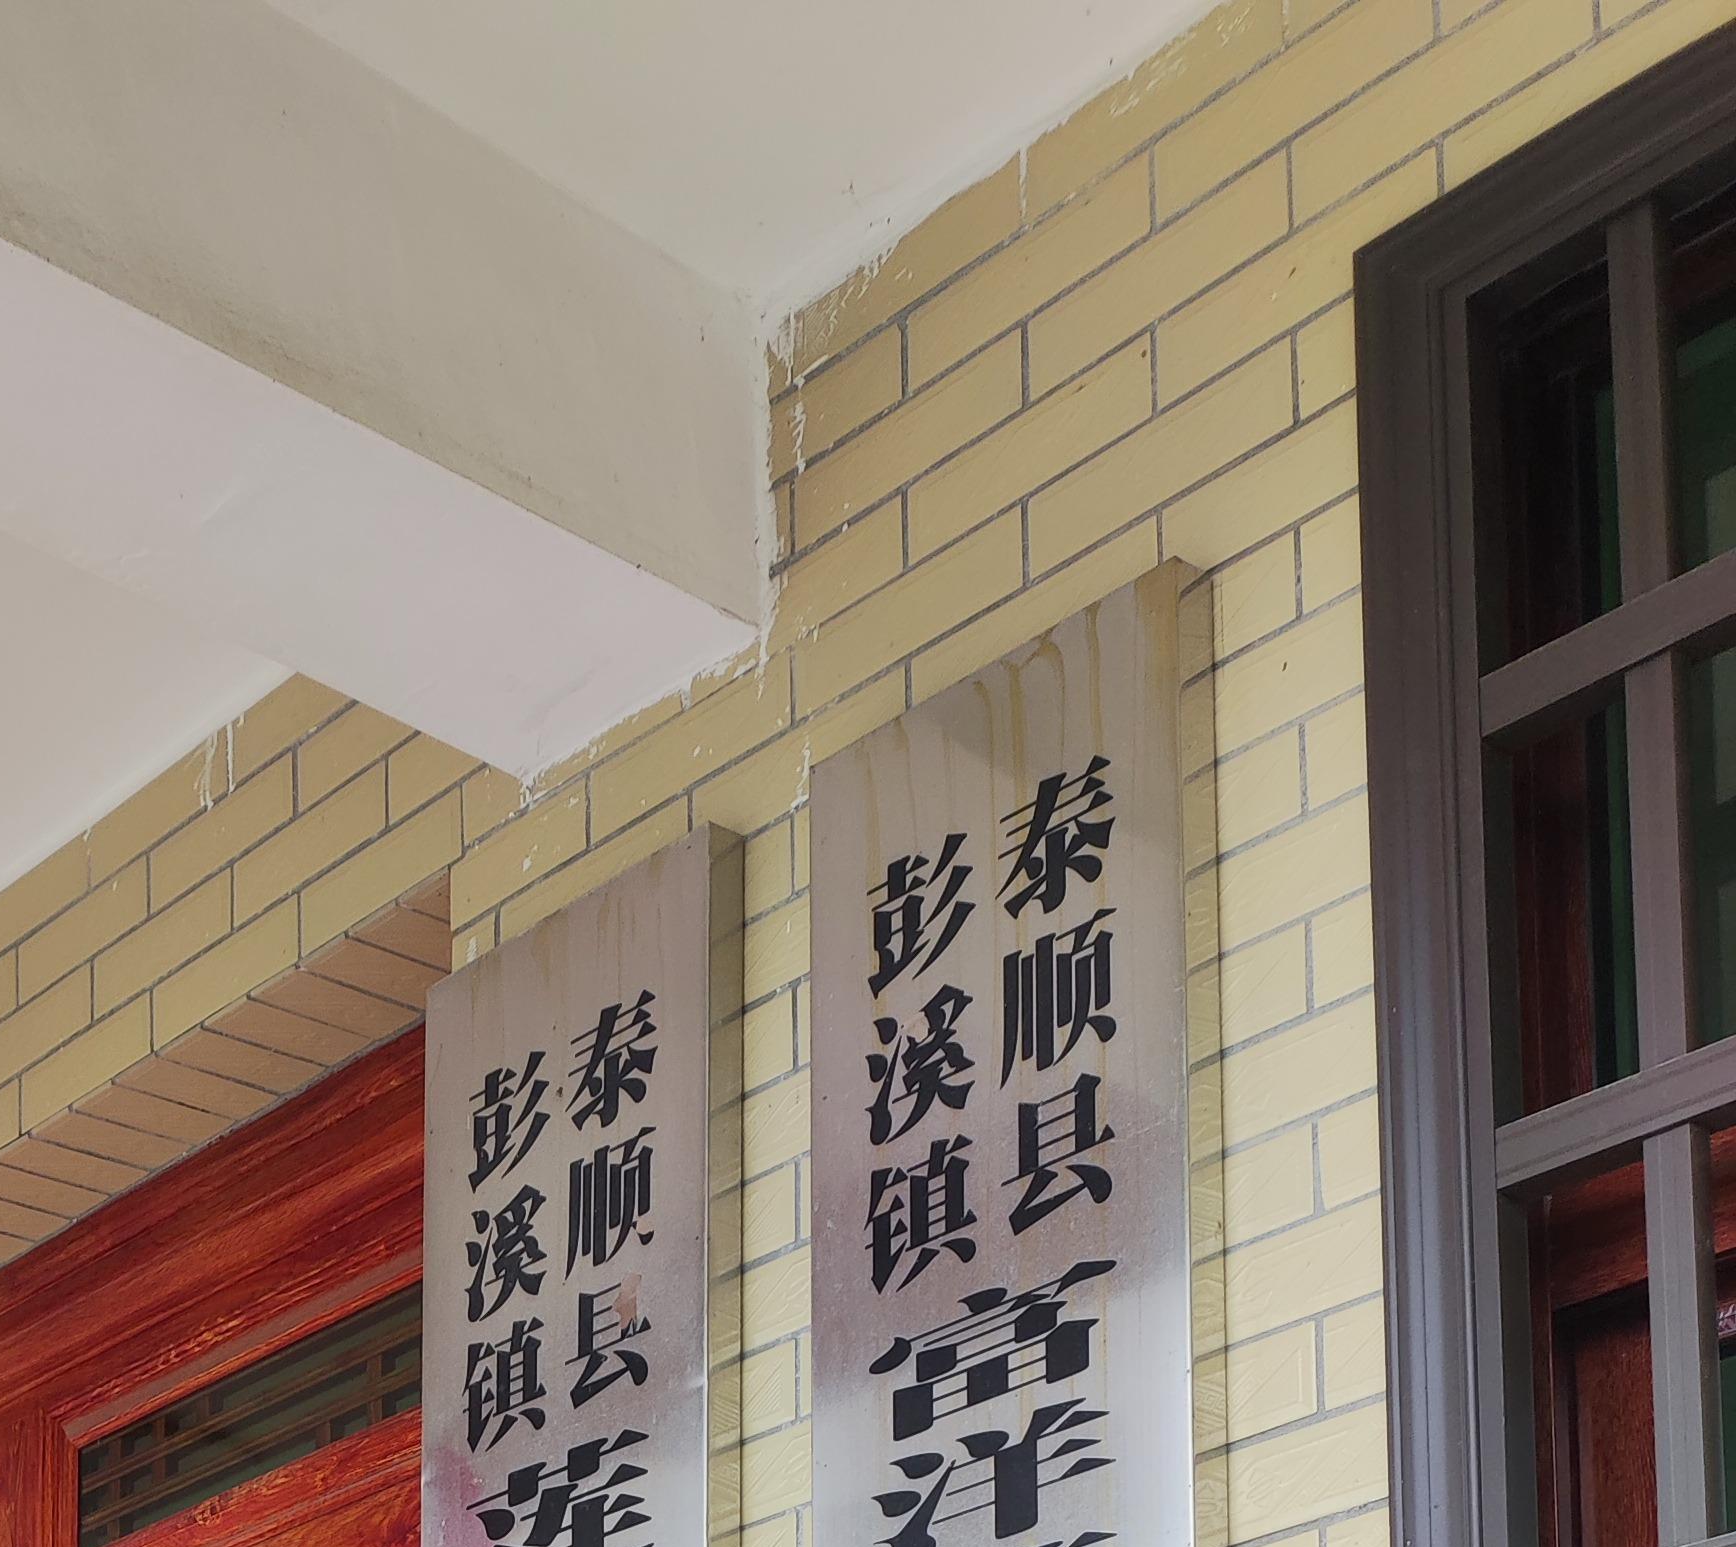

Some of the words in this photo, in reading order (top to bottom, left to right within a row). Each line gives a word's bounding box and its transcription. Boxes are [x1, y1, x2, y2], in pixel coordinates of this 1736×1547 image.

[565, 989, 658, 1409] 泰顺县
[865, 832, 978, 1295] 彭溪镇
[994, 754, 1117, 1236] 泰顺县
[462, 1050, 551, 1453] 彭溪镇
